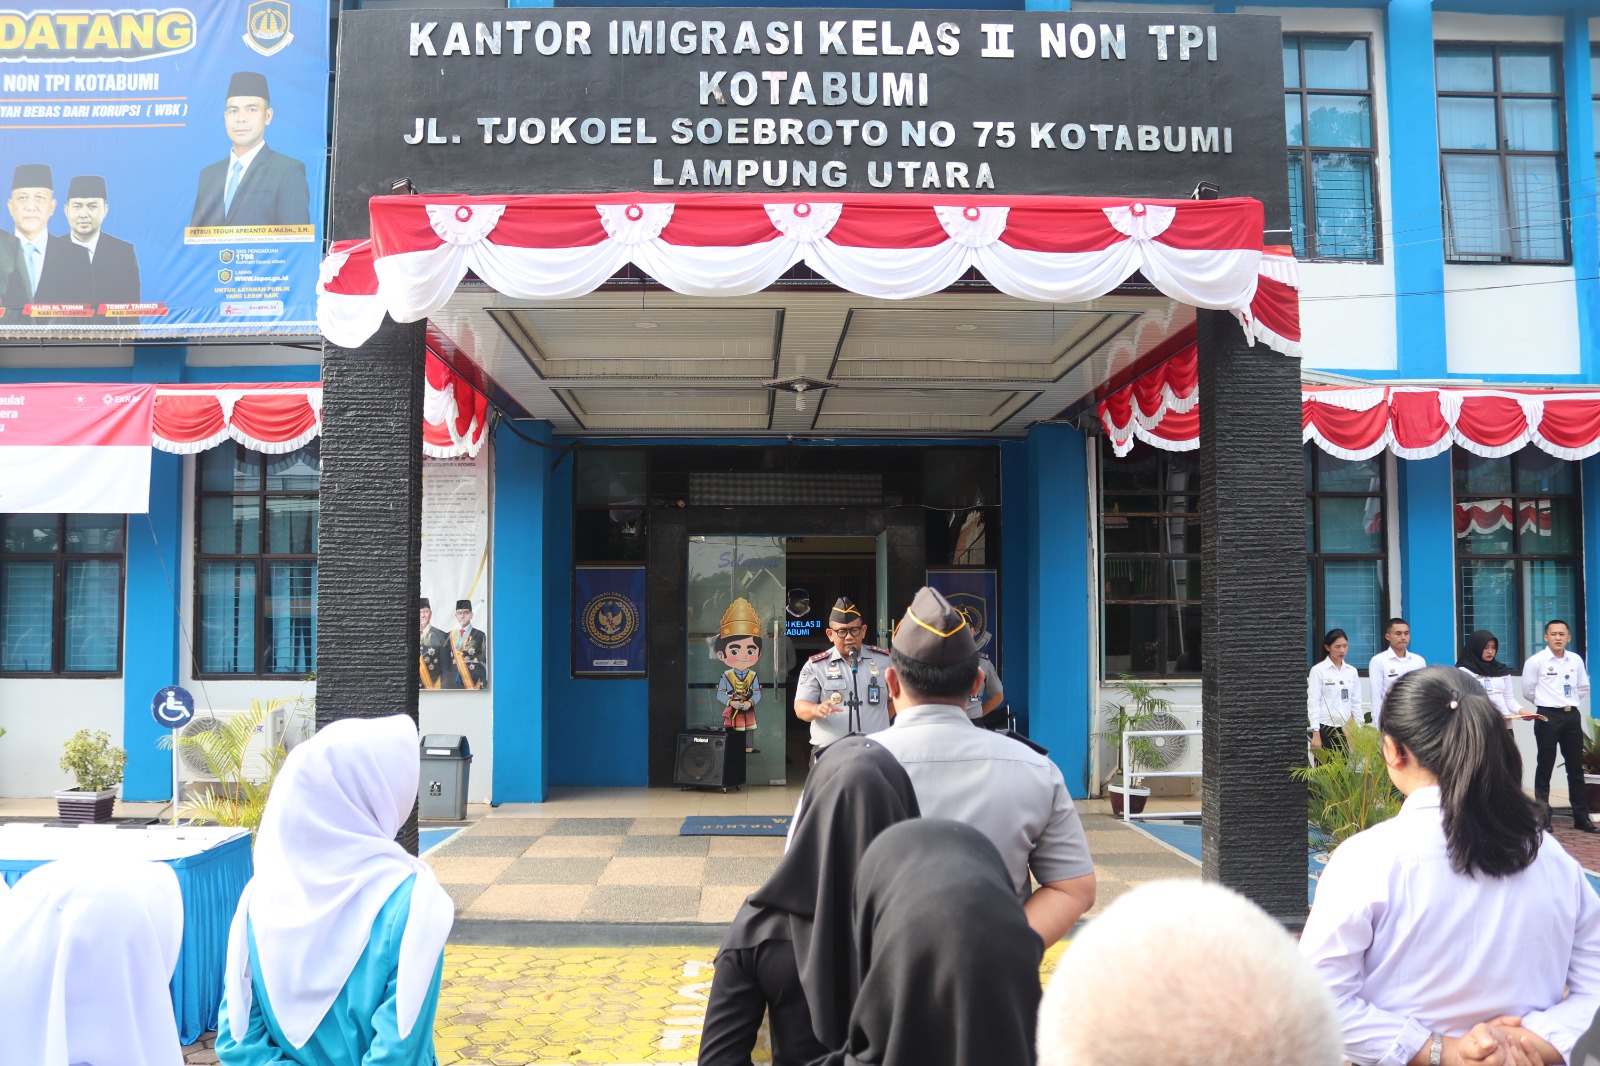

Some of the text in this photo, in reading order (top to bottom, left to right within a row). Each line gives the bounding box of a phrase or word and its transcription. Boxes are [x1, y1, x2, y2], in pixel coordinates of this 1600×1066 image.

[0, 13, 191, 50] DATANG
[409, 20, 1218, 61] KANTOR IMIGRASI KELAS II NON TPI
[3, 73, 160, 92] NON TPI KOTABUMI
[699, 70, 929, 107] KOTABUMI
[23, 105, 61, 118] BEBAS
[63, 105, 90, 118] DARI
[92, 104, 141, 117] KORUPSI
[403, 116, 1233, 154] JL. TJOKOEL SOEBROTO NO 75 KOTABUMI
[653, 158, 996, 189] LAMPUNG UTARA
[790, 620, 815, 628] KELAS
